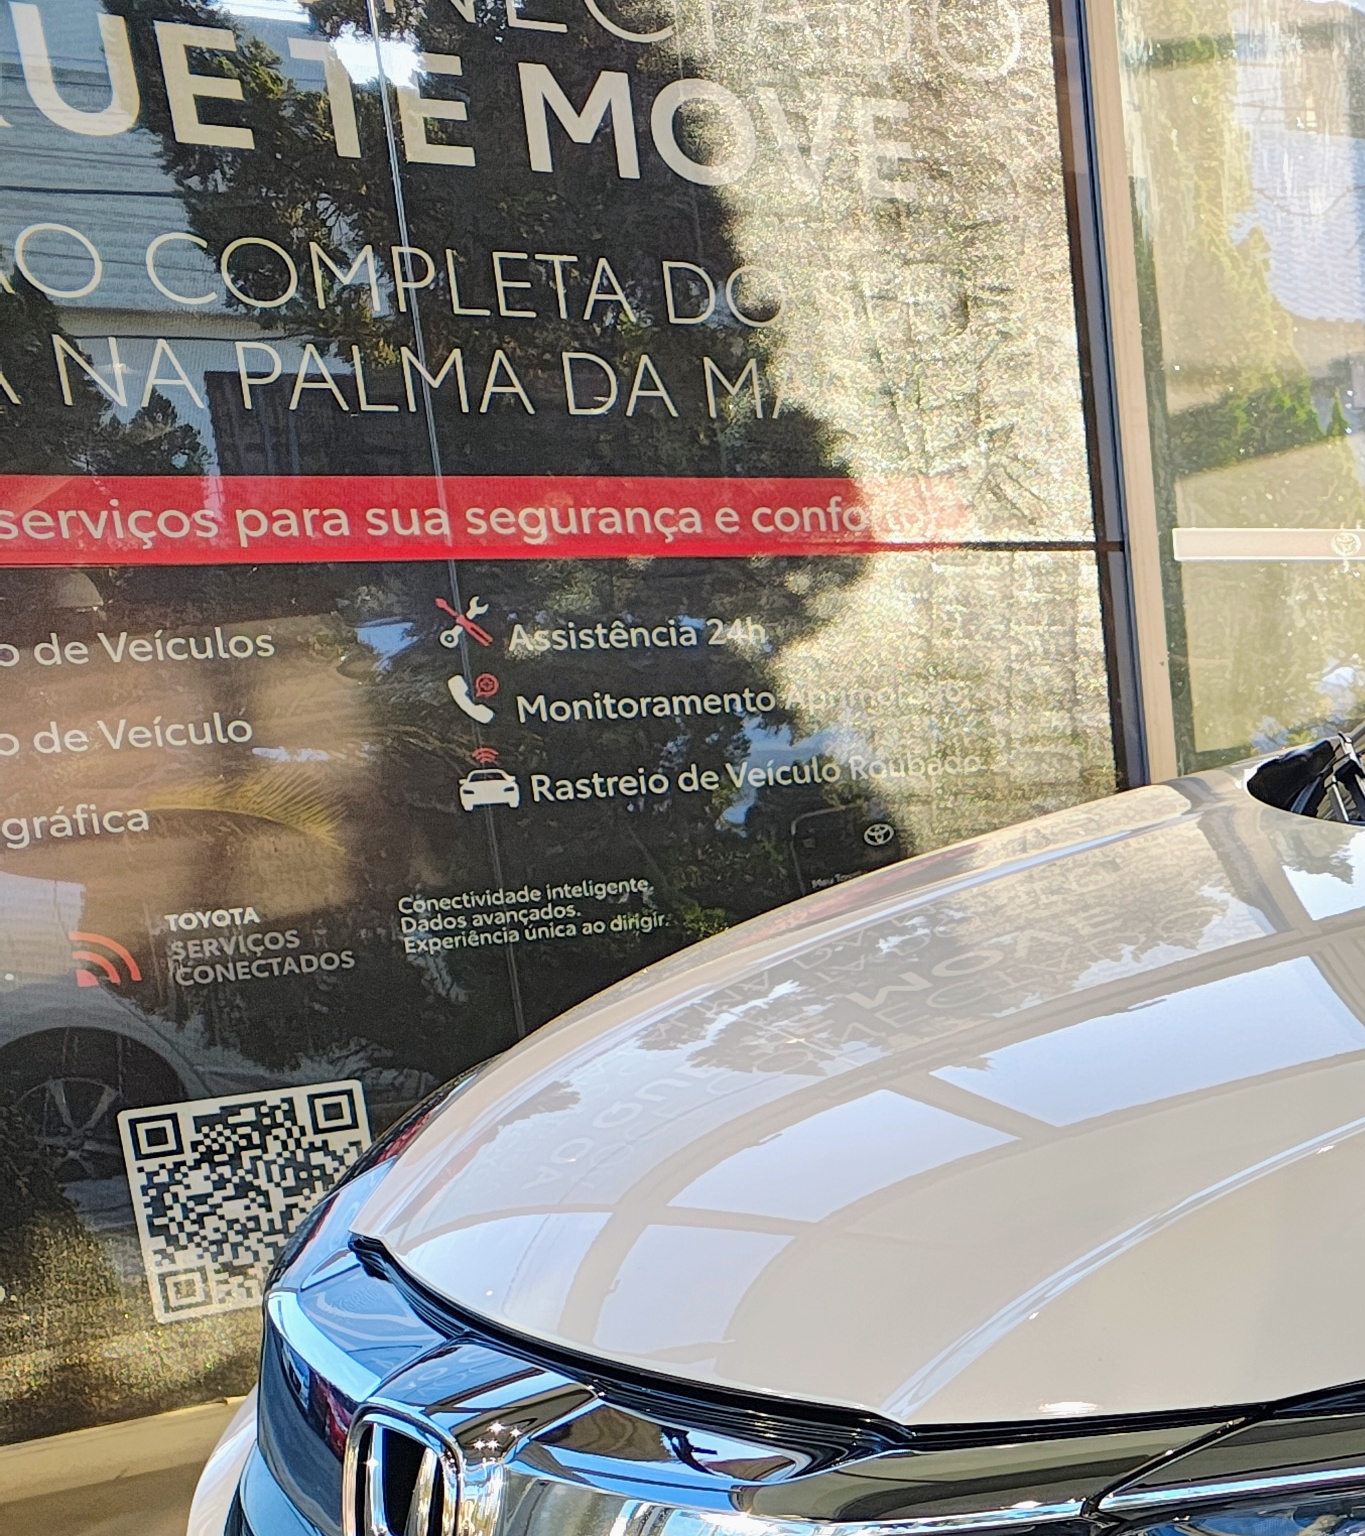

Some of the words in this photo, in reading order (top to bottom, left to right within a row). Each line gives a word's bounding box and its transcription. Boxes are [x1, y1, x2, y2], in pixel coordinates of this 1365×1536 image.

[0, 2, 255, 150] UE
[288, 37, 476, 167] TE
[517, 62, 918, 200] MOVE
[0, 223, 102, 298] O
[146, 232, 636, 324] COMPLETA
[52, 334, 204, 408] NA
[235, 341, 535, 416] PALMA
[562, 350, 678, 418] DA
[0, 499, 219, 550] serviços
[236, 507, 350, 548] para
[366, 504, 451, 537] sua
[464, 505, 702, 544] segurança
[715, 506, 740, 533] e
[751, 496, 870, 534] confo
[34, 632, 90, 666] de
[97, 626, 275, 663] Veículos
[508, 619, 698, 652] Assistência
[706, 617, 767, 647] 24h
[516, 688, 777, 724] Monitoramento
[34, 721, 90, 754] de
[97, 712, 253, 750] Veículo
[531, 768, 669, 802] Rastreio
[678, 763, 720, 792] de
[725, 757, 842, 789] Veículo
[1, 804, 150, 849] gráfica
[398, 885, 542, 914] Conectividade
[546, 877, 654, 901] inteligente.
[164, 907, 260, 932] TOYOTA
[401, 912, 467, 934] Dados
[472, 903, 582, 928] avançados.
[404, 927, 520, 954] Experiência
[525, 923, 577, 942] única
[582, 921, 606, 935] ao
[610, 912, 670, 933] dirigir.
[170, 930, 300, 960] SERVIÇOS
[175, 951, 356, 987] CONECTADOS
